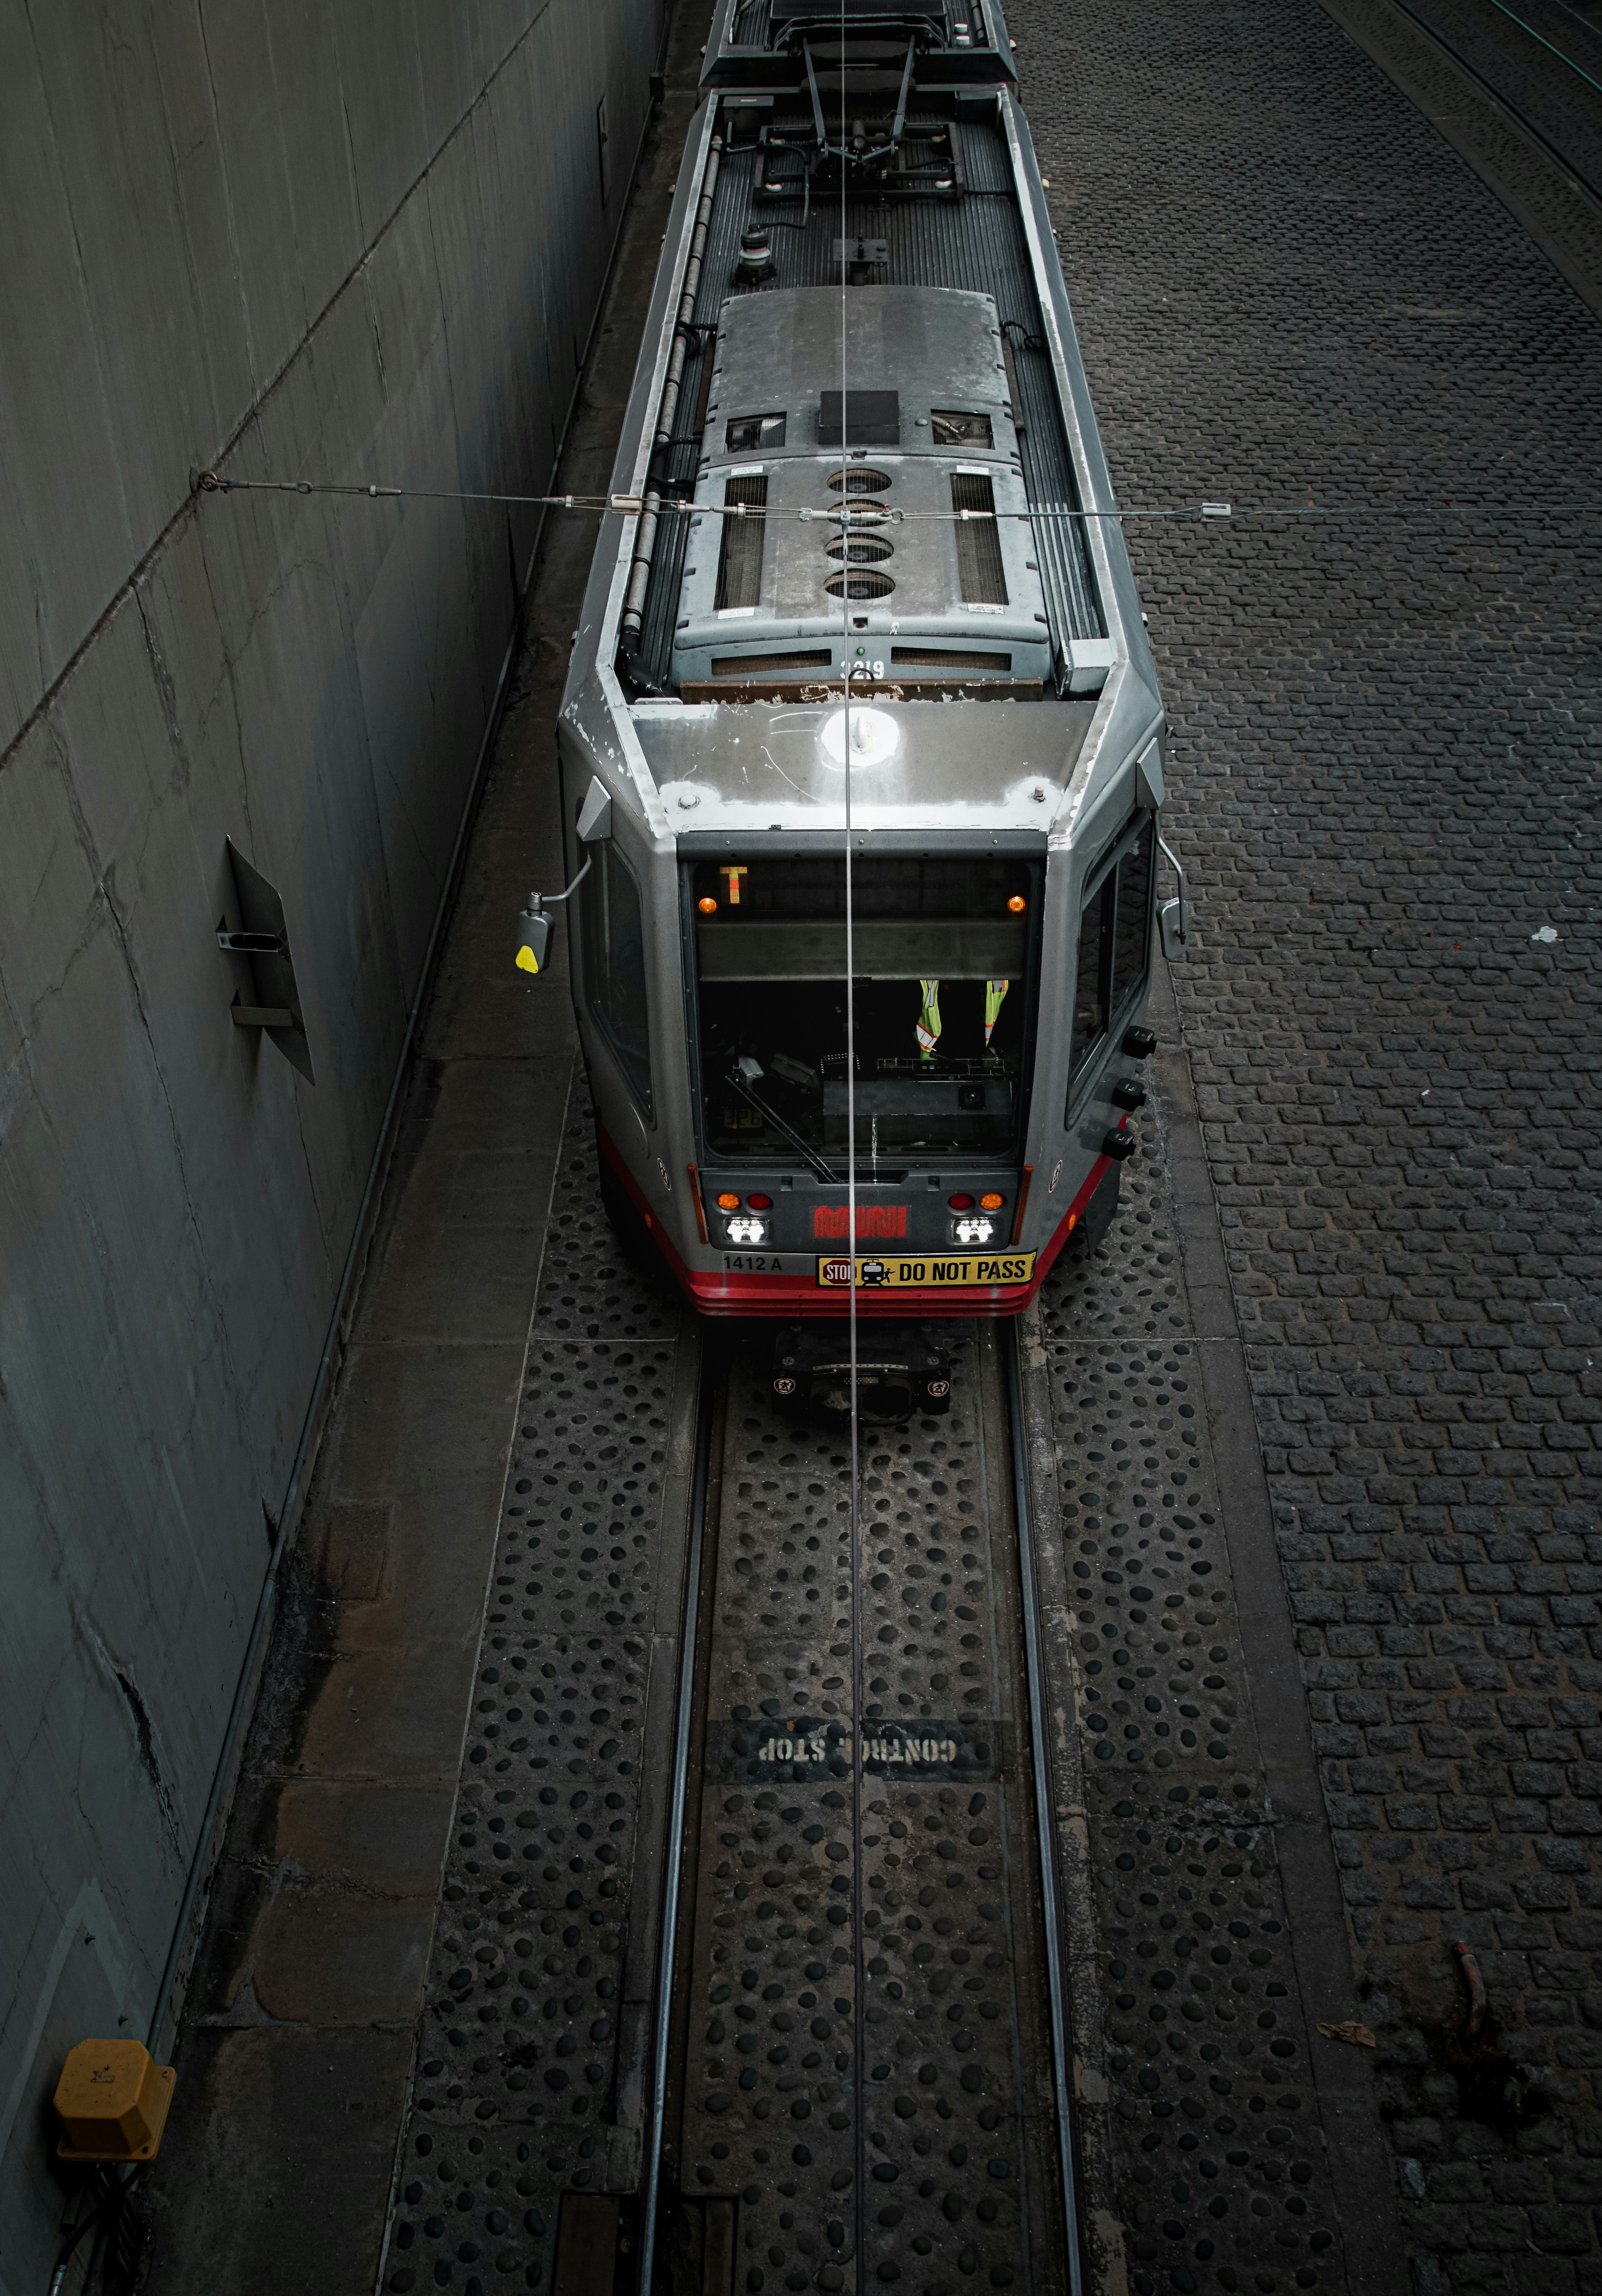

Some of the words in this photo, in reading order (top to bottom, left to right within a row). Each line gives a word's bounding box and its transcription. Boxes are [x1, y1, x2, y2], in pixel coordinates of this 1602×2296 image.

[840, 660, 884, 680] 3219
[720, 866, 747, 904] T
[723, 1256, 766, 1270] 1412
[771, 1258, 782, 1271] A
[899, 1263, 925, 1281] DO
[933, 1262, 971, 1281] NOT
[977, 1260, 1026, 1280] PASS
[759, 1737, 825, 1762] STOP
